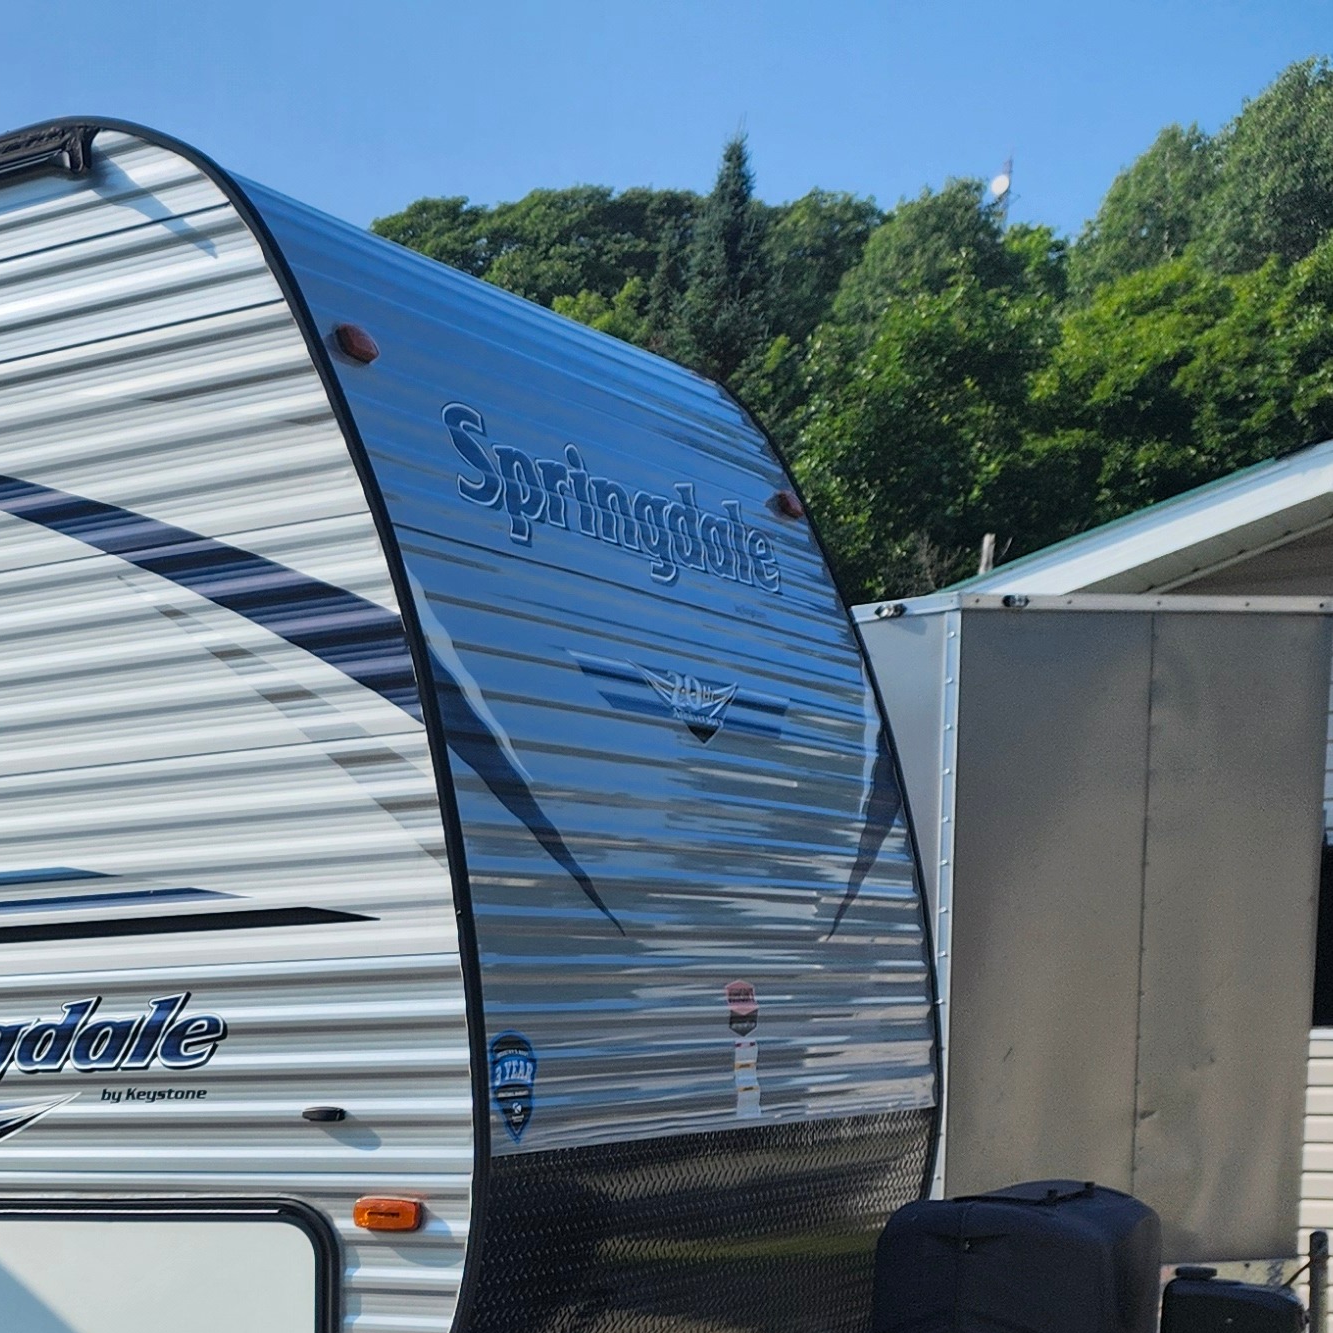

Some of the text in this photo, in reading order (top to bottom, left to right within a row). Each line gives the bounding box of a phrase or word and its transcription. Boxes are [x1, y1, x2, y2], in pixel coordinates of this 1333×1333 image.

[441, 401, 782, 594] Springdale
[495, 1060, 534, 1086] 3 YEAR
[100, 1087, 207, 1104] by Keystone
